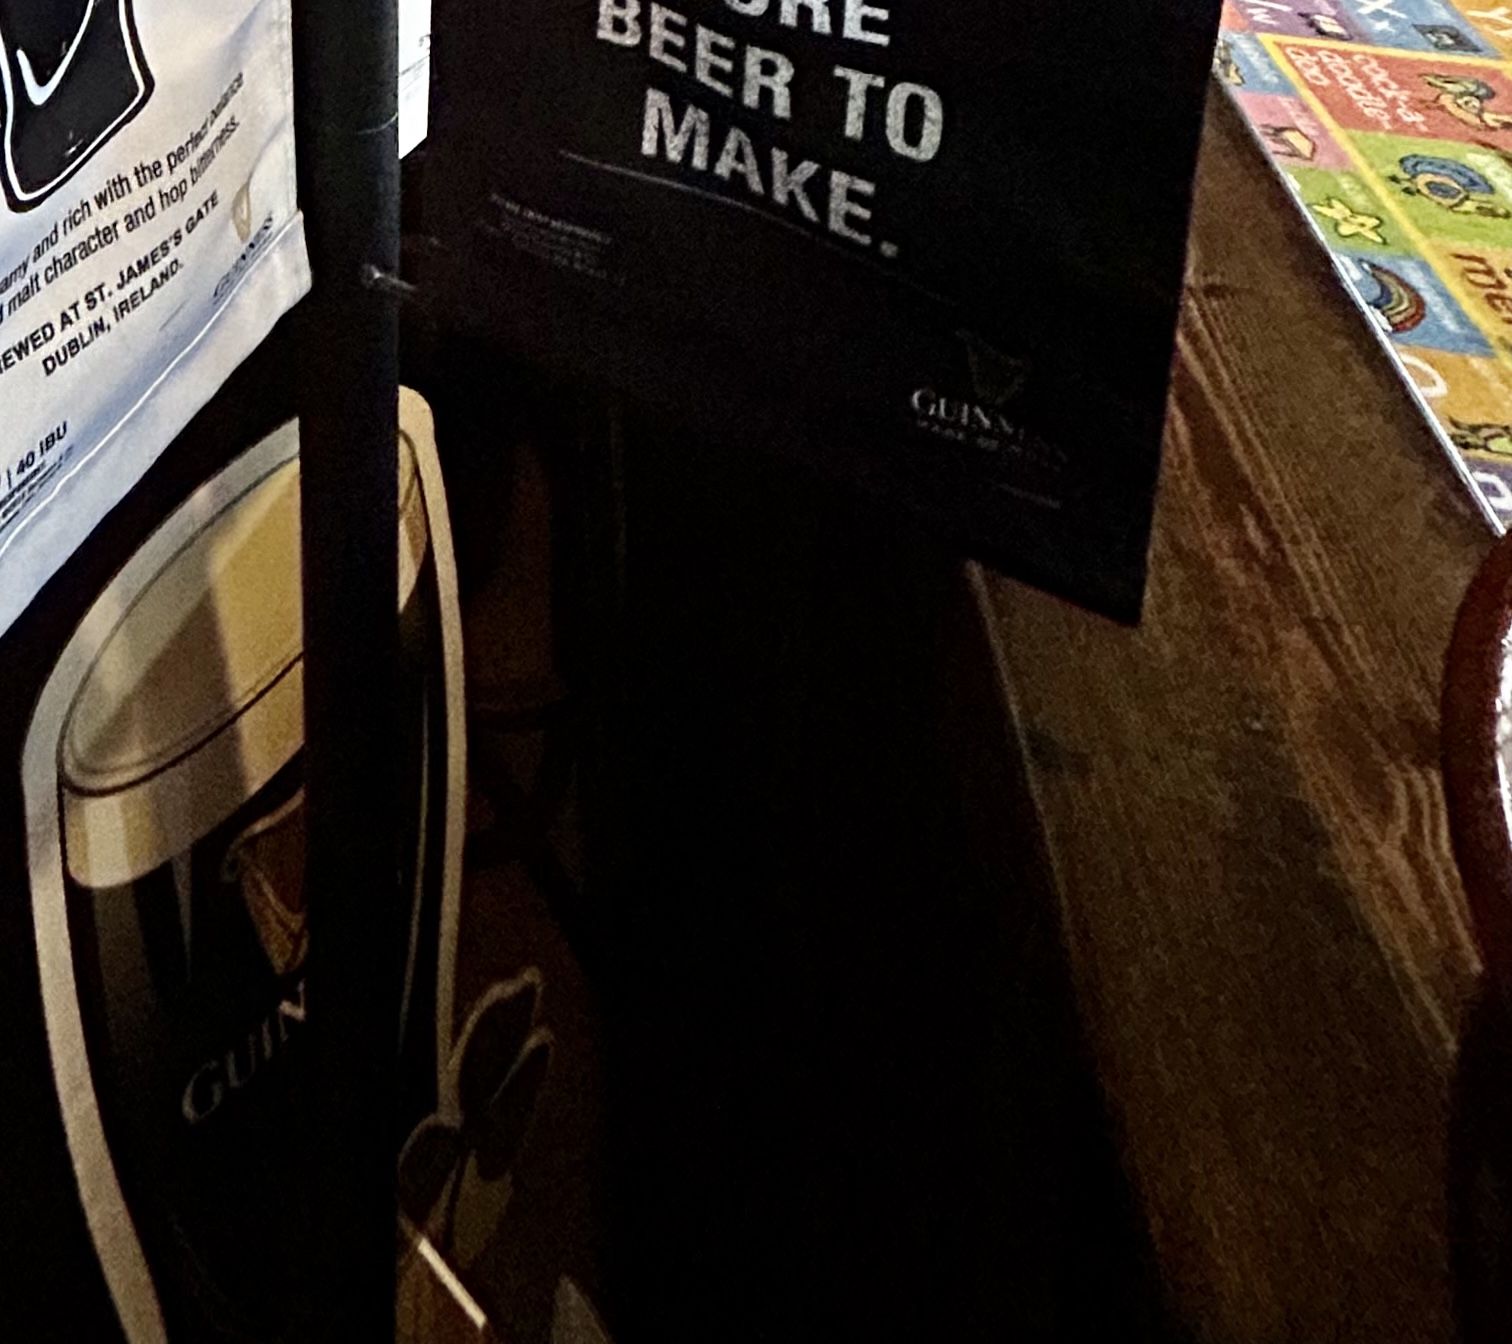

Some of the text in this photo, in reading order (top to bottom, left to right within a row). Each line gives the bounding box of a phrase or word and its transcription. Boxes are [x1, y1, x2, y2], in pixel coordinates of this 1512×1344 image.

[640, 86, 900, 258] MAKE.
[834, 64, 945, 162] TO
[7, 273, 41, 317] malt
[43, 219, 120, 285] character
[123, 195, 156, 233] and
[158, 177, 188, 213] hop
[32, 223, 59, 263] and
[63, 199, 92, 238] rich
[94, 174, 131, 210] with
[134, 157, 163, 188] the
[59, 301, 81, 333] AT
[83, 281, 113, 312] ST.
[116, 227, 183, 290] JAMES'S
[185, 189, 220, 235] GATE
[40, 316, 112, 378] DUBLIN,
[112, 257, 185, 322] IRELAND.
[17, 450, 36, 476] 40
[39, 420, 68, 458] IBU
[181, 976, 307, 1125] GUIN
